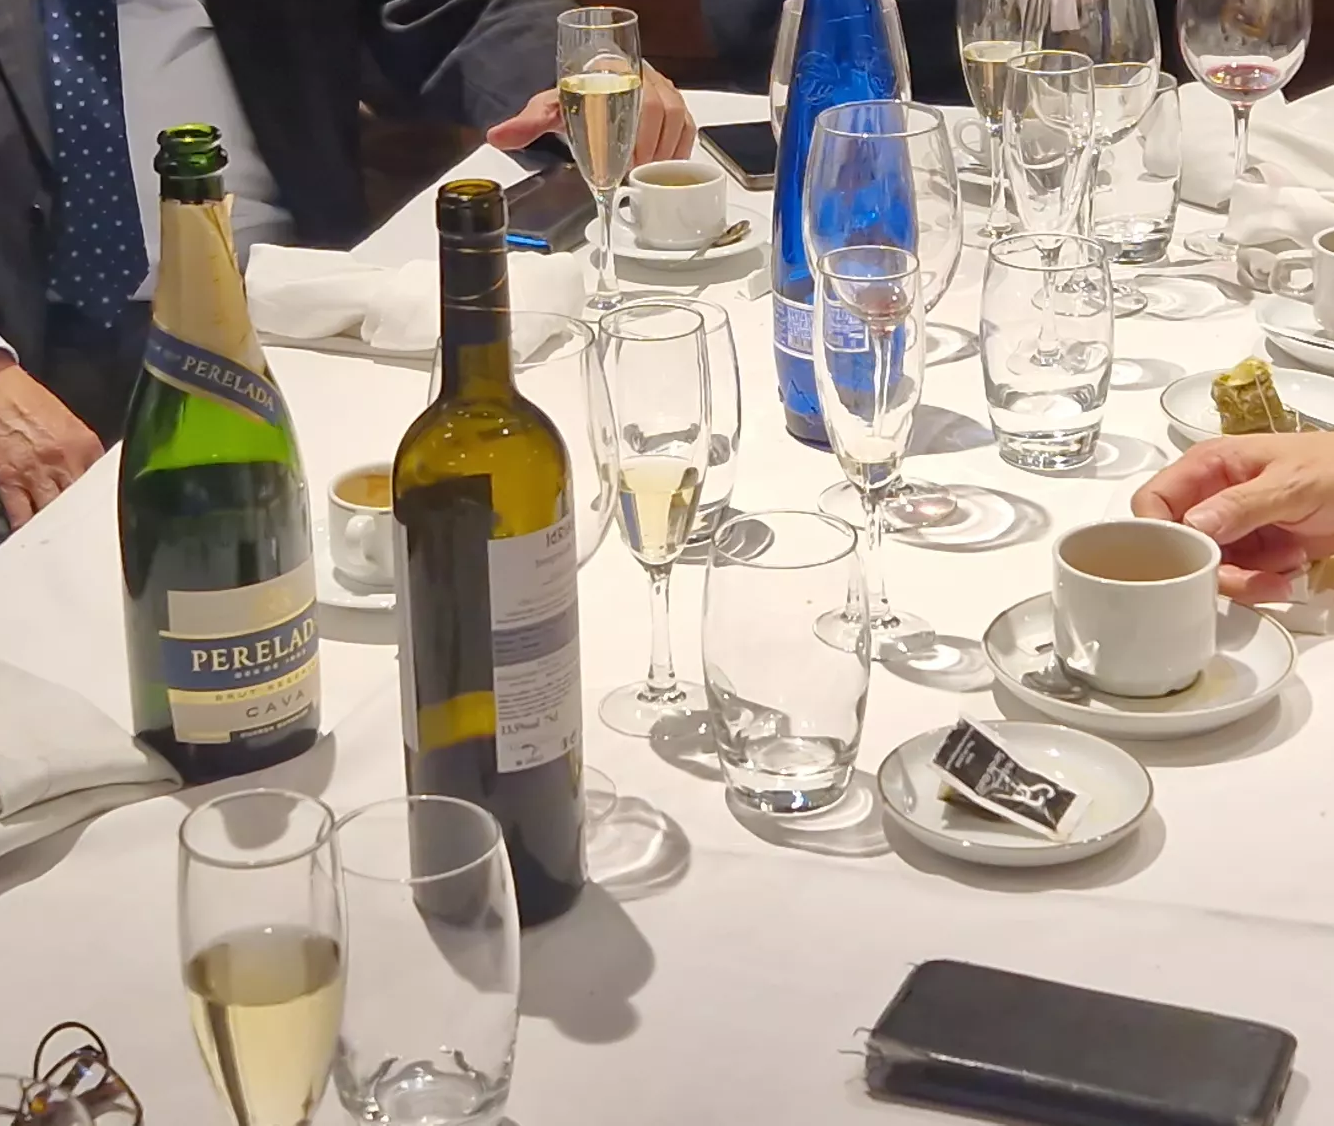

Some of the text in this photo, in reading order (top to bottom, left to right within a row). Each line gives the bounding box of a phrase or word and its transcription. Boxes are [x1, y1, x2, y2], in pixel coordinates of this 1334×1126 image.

[181, 355, 275, 412] PERELADA
[190, 617, 318, 672] PERELAD
[245, 689, 305, 718] CAVA
